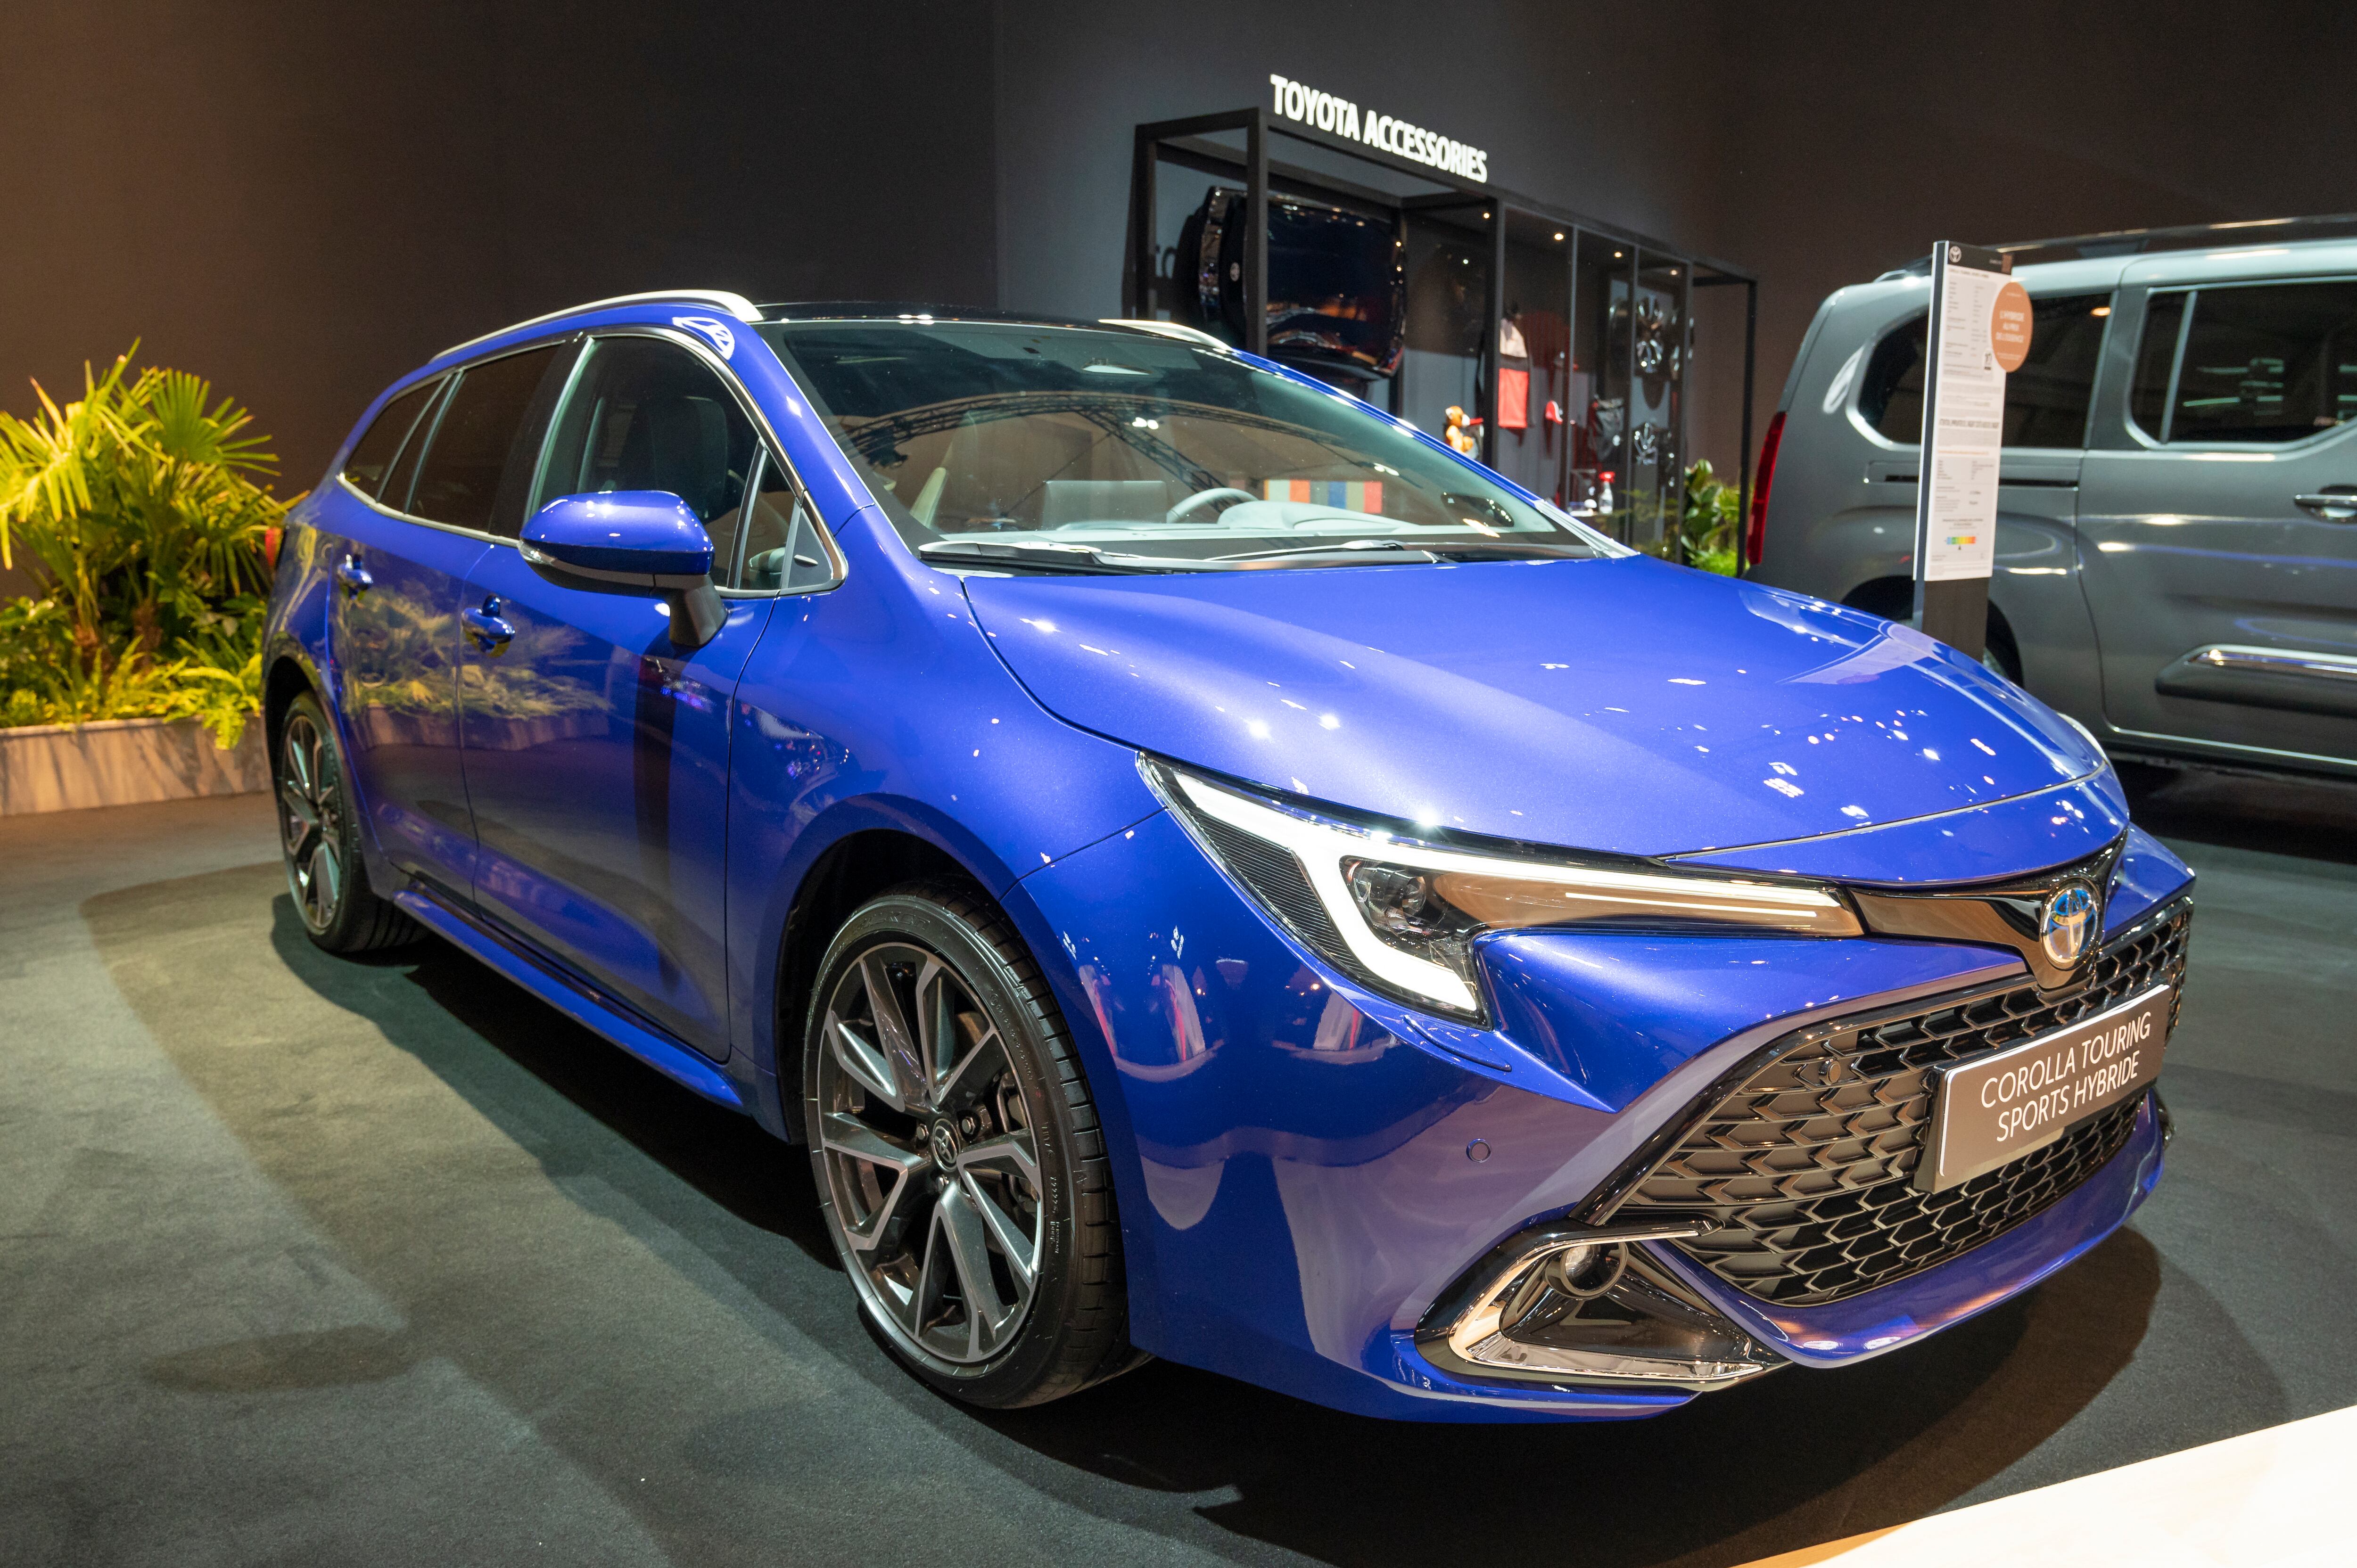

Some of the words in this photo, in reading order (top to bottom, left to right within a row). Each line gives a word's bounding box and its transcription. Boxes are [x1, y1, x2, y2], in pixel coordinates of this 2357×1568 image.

[1270, 74, 1360, 141] TOYOTA
[1362, 110, 1488, 183] ACCESSORIES
[1981, 1047, 2076, 1108] COROLLA
[2081, 1011, 2151, 1068] TOURING
[1996, 1085, 2070, 1142] SPORTS
[2074, 1050, 2140, 1108] HYBRIDE
